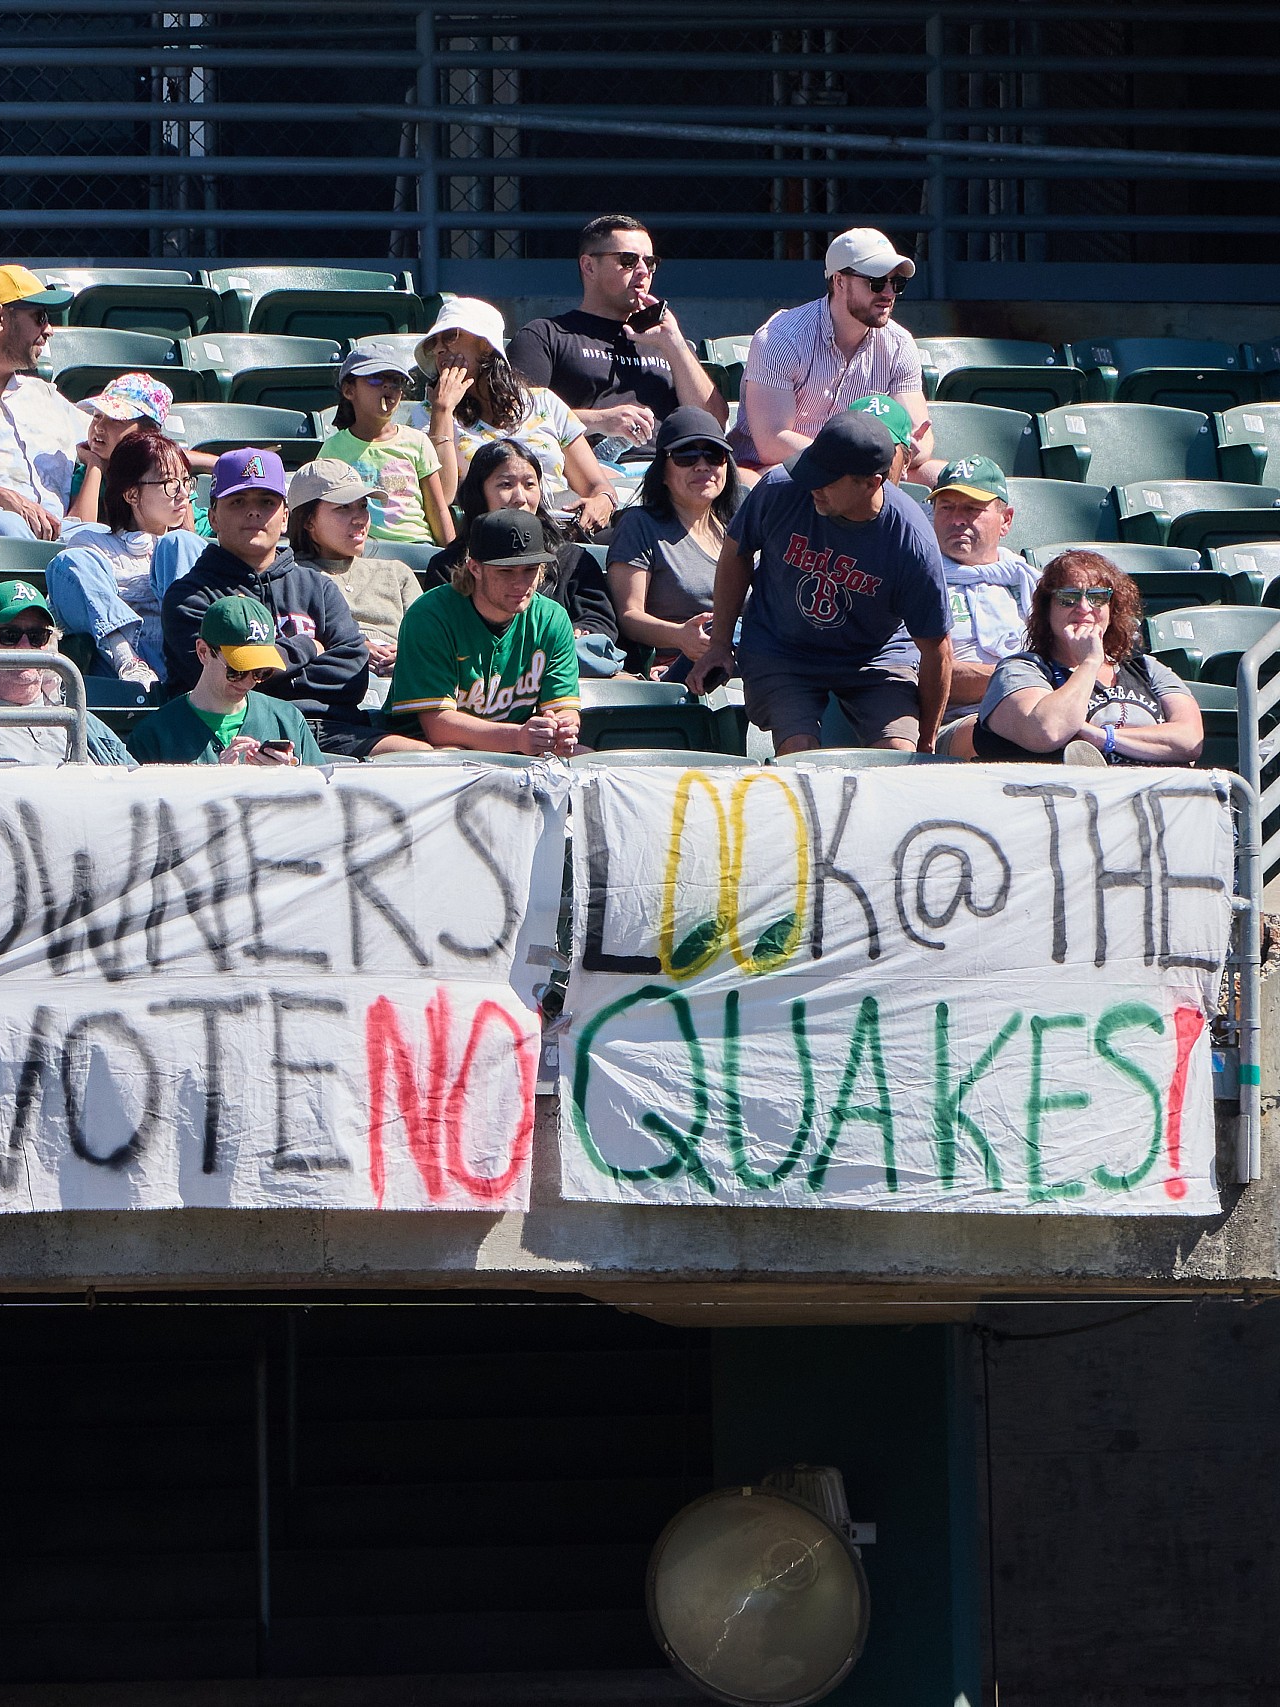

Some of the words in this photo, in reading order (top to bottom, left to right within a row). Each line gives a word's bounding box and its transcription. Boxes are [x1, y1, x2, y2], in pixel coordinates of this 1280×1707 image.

[582, 348, 614, 361] RIFLE
[620, 354, 671, 371] DYNAMICS
[862, 397, 890, 416] A's
[949, 459, 975, 479] A's
[510, 526, 532, 549] A's
[783, 532, 834, 574] Red
[829, 554, 883, 597] Sox
[11, 582, 37, 602] A's
[802, 570, 839, 622] B
[246, 619, 270, 641] A's
[457, 649, 546, 715] kland
[1087, 685, 1158, 714] ASEBALL
[365, 985, 536, 1209] NO
[573, 985, 1204, 1200] QUAKES!
